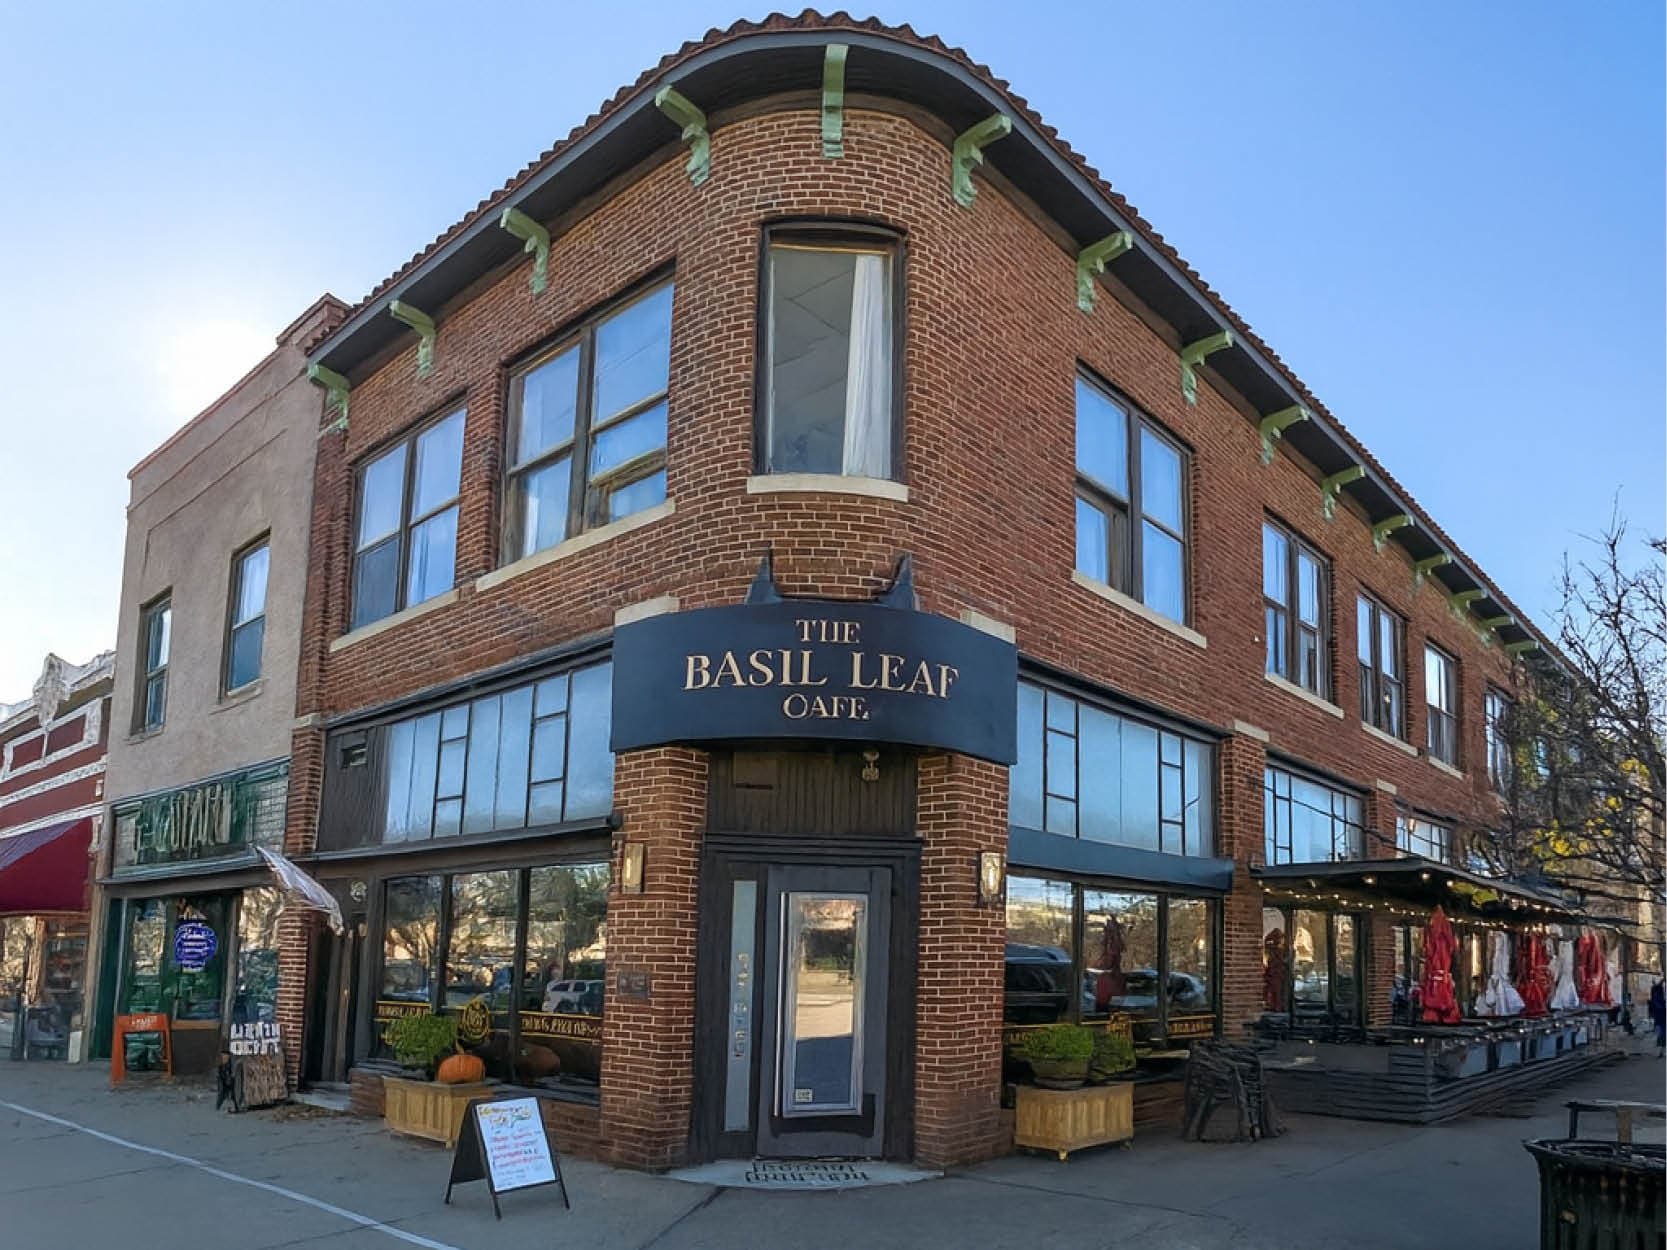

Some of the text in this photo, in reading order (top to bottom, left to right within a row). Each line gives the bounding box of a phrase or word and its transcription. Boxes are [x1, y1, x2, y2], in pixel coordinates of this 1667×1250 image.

[796, 619, 861, 644] THE
[681, 649, 960, 699] BASIL LEAF
